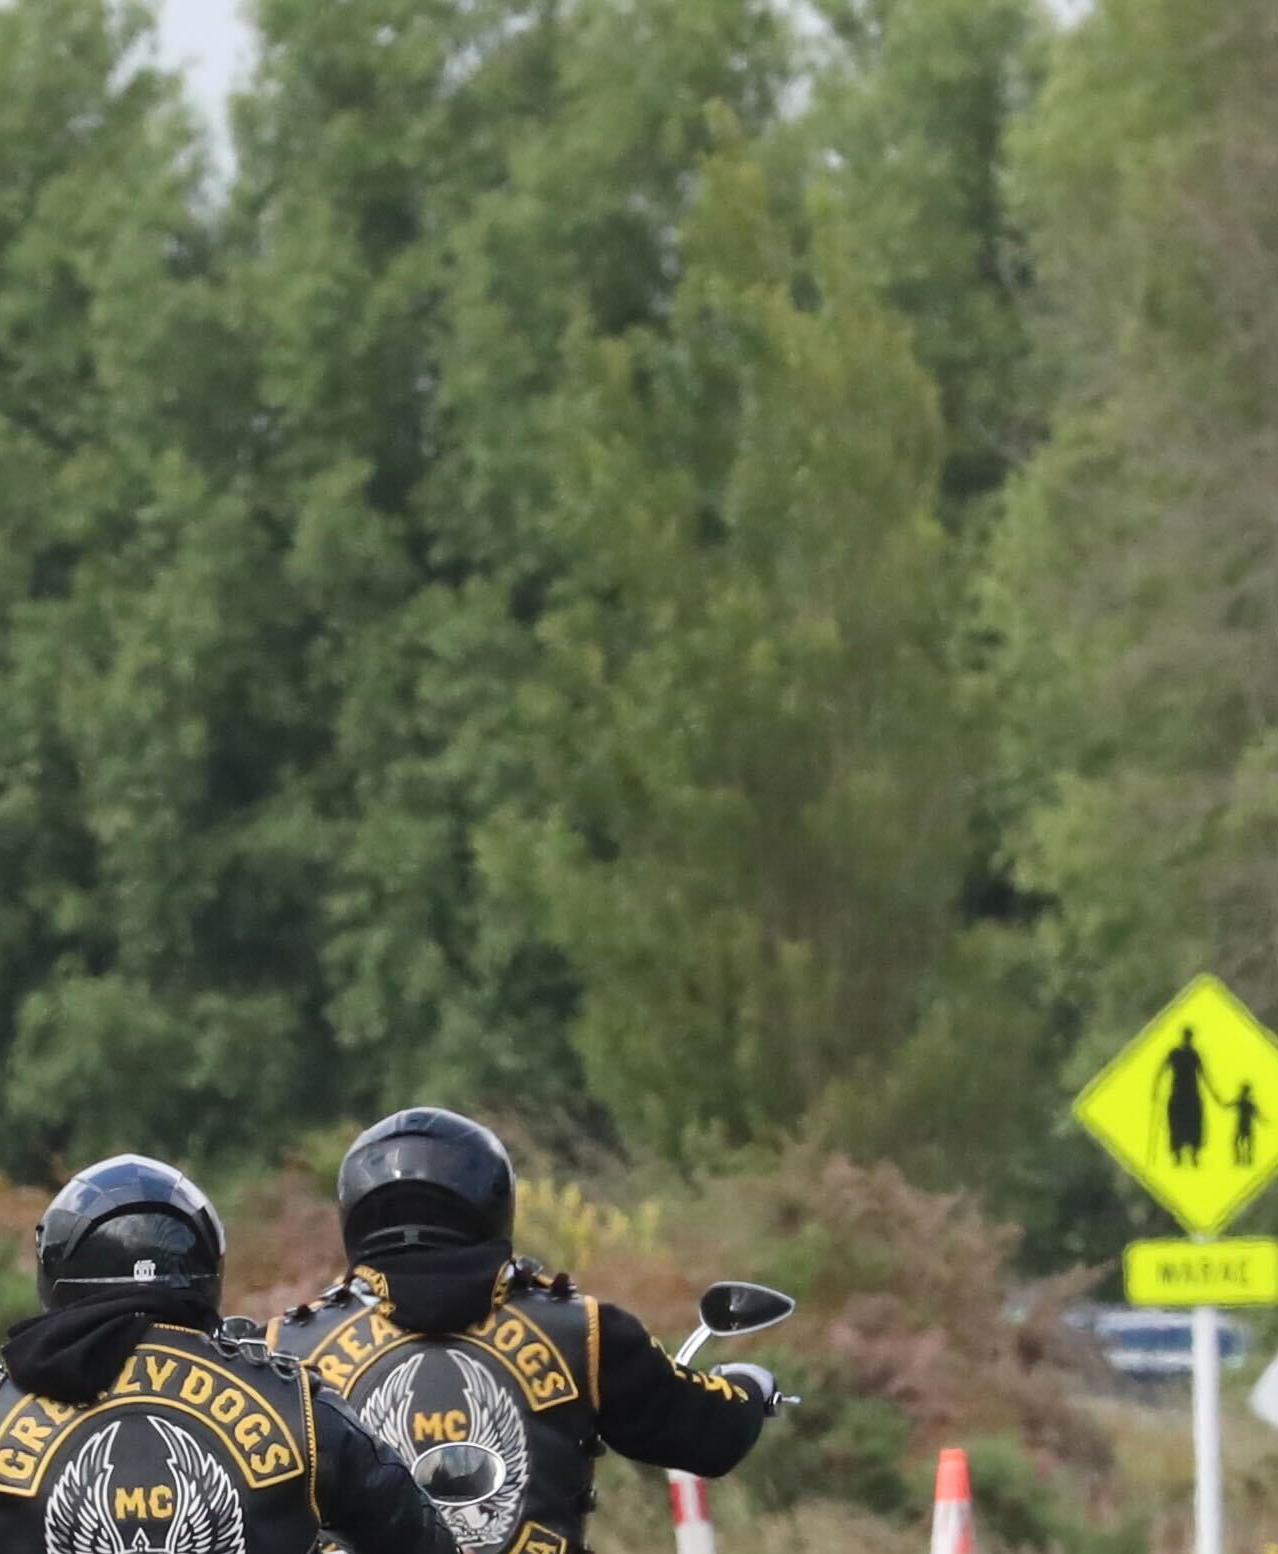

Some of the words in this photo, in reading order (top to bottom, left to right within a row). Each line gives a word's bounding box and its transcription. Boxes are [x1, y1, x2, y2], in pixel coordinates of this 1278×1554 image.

[179, 1366, 292, 1477] DOGS
[412, 1408, 468, 1442] MC
[114, 1484, 173, 1520] MC
